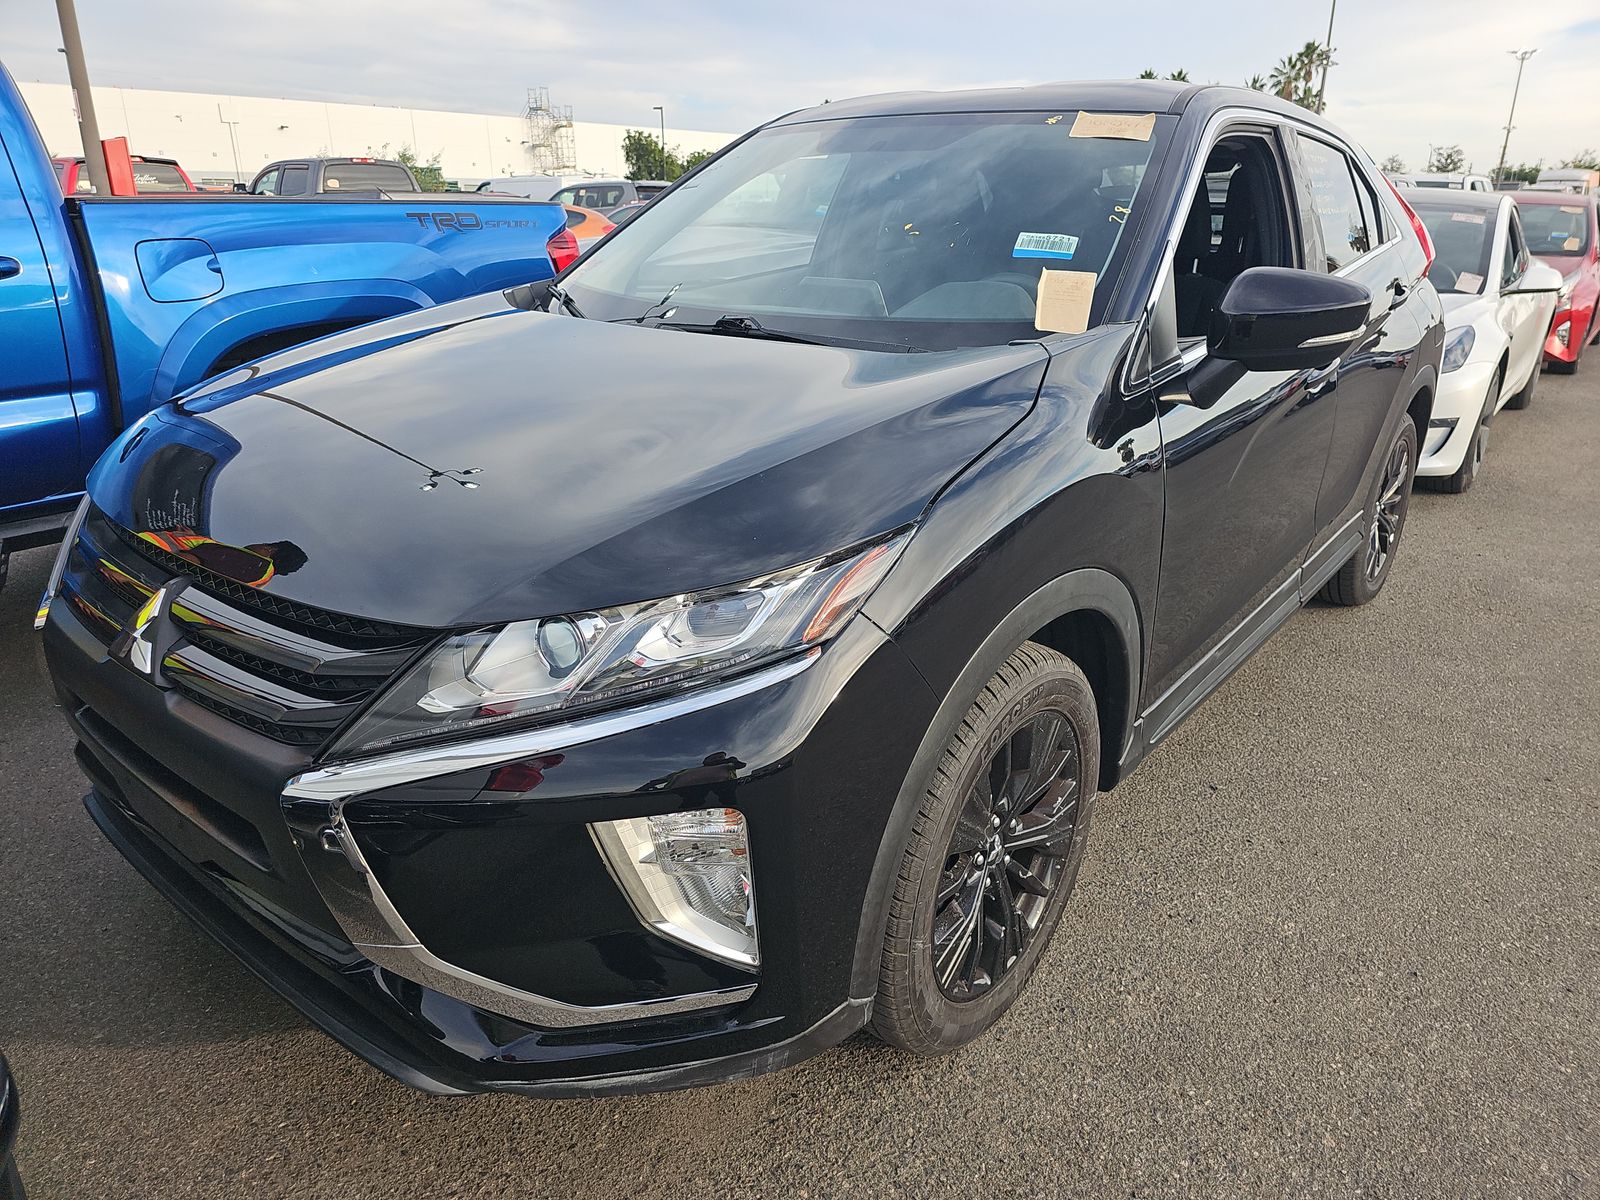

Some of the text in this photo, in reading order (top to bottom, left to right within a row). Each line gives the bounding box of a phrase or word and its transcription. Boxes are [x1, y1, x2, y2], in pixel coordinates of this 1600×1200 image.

[405, 212, 537, 234] TRD SPORT
[981, 694, 1032, 766] FORCE
